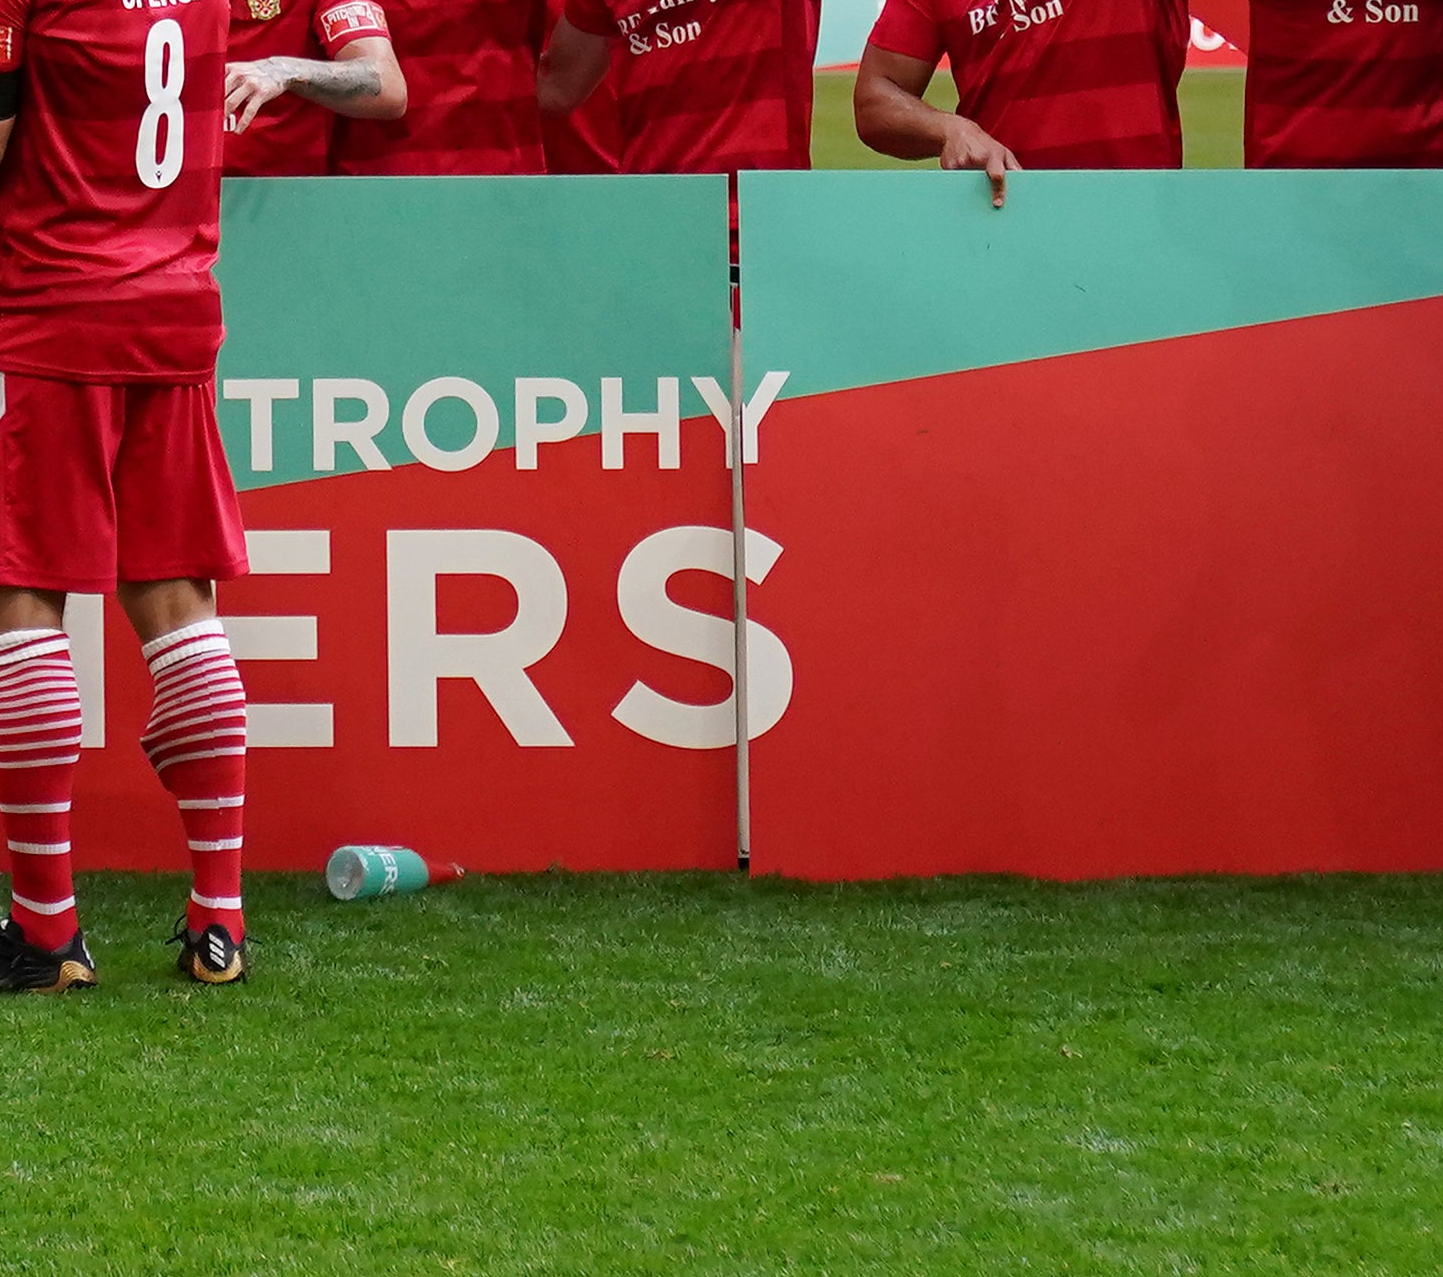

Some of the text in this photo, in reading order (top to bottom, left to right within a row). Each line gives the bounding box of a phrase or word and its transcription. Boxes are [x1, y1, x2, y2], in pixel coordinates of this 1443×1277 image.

[628, 19, 703, 56] & Son
[134, 18, 186, 190] 8
[225, 371, 791, 474] TROPHY
